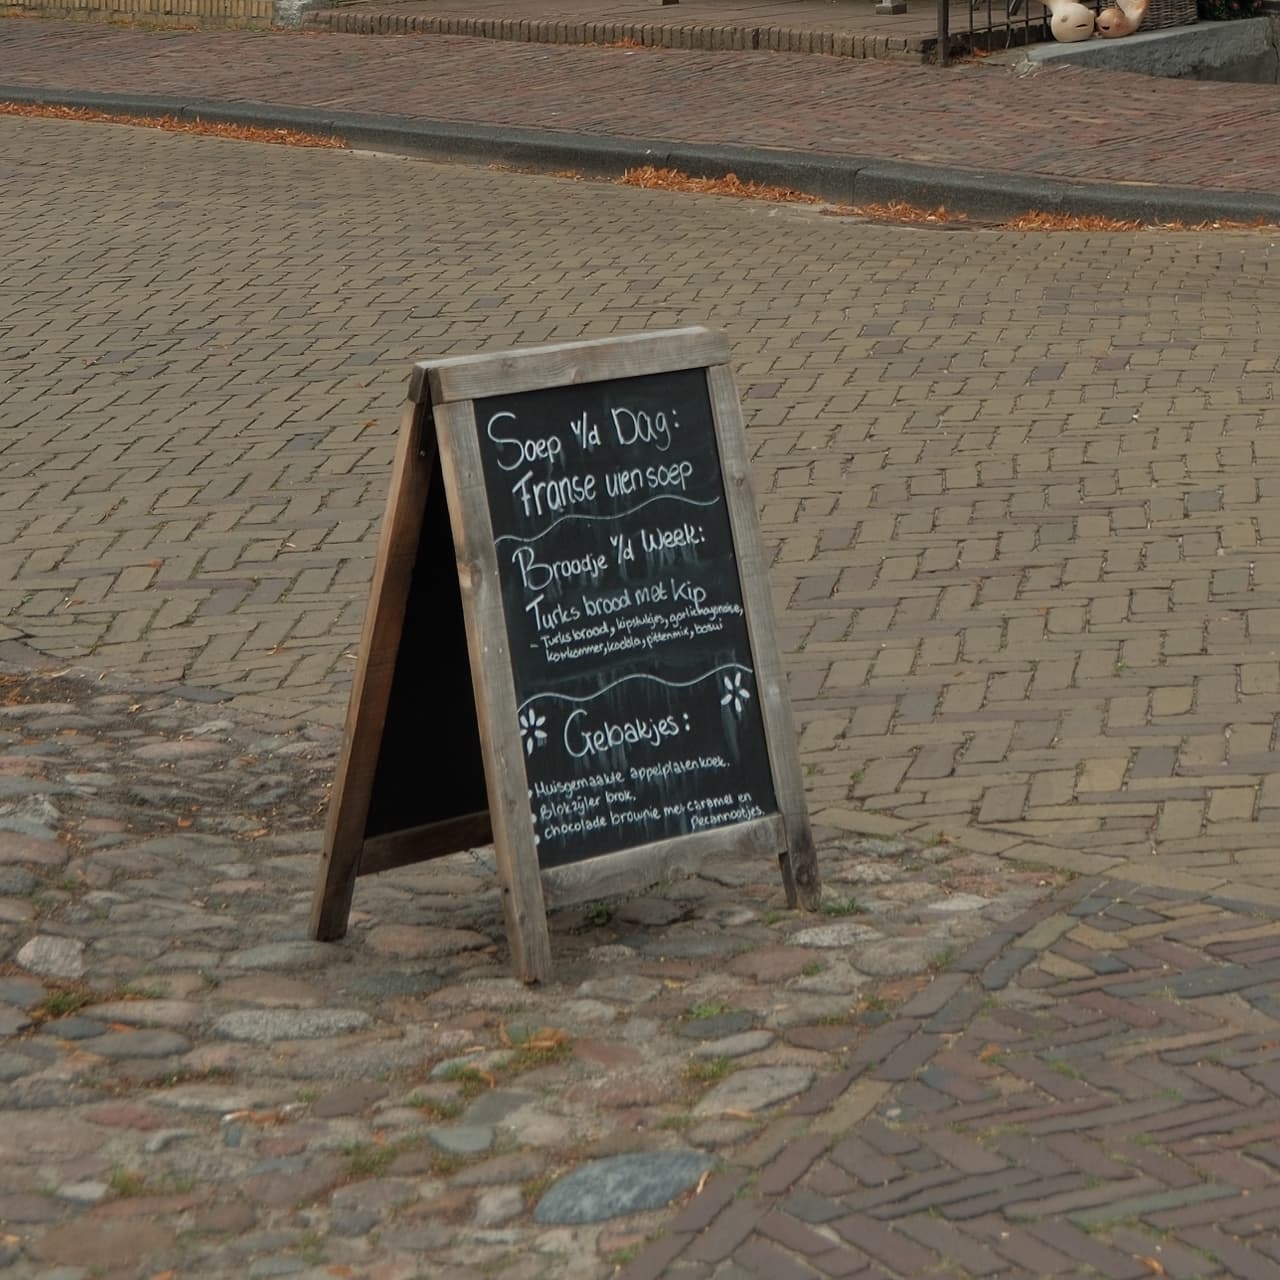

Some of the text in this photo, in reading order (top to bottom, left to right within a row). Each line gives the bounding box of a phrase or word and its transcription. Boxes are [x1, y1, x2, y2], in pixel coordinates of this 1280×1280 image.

[487, 407, 680, 471] Soep v/d Dag:
[512, 470, 596, 517] Franse
[512, 523, 706, 591] Broodje v/d Week:
[525, 578, 707, 631] Turks brood met Kip
[564, 709, 691, 758] Gebakjes:
[534, 771, 625, 797] Huisgemaakte
[544, 792, 752, 840] chocolade brownie met caramel en
